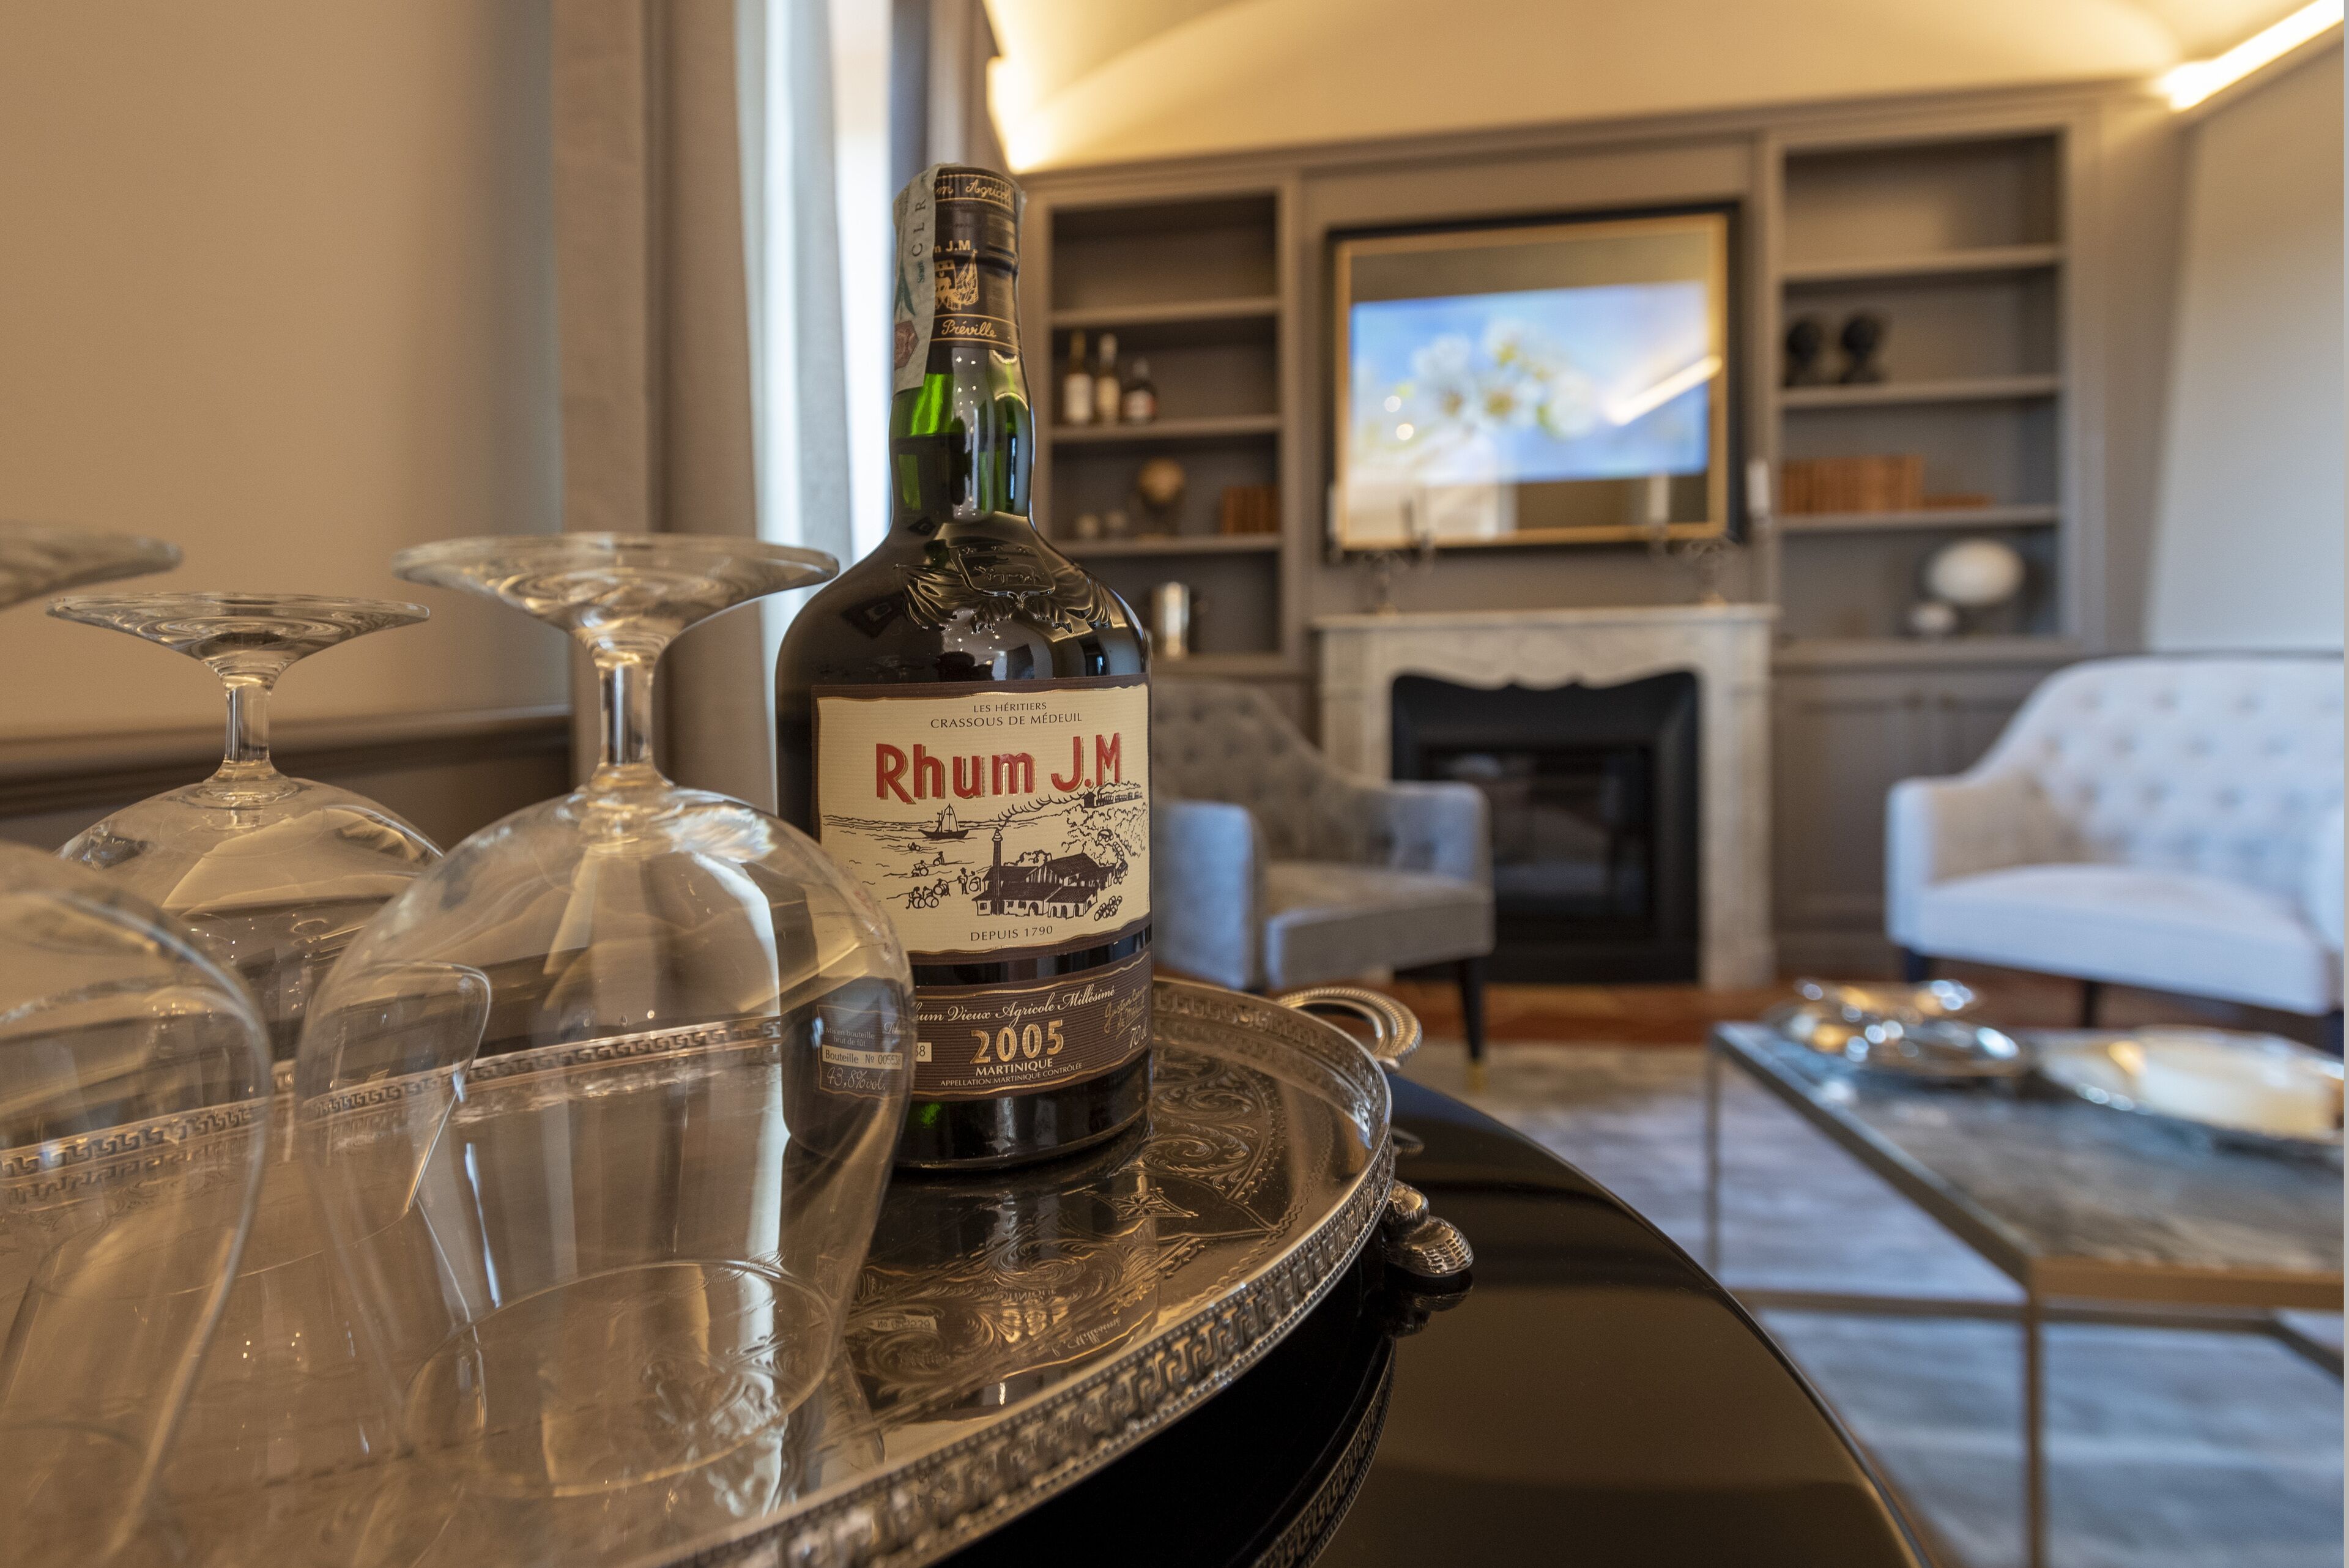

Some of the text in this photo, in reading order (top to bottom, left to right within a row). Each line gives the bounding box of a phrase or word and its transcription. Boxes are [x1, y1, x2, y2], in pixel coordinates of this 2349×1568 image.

[965, 179, 1010, 200] Agricol
[946, 240, 971, 252] J.M
[941, 319, 996, 338] Préville
[973, 702, 1047, 713] LES HÉRITIERS
[930, 712, 1082, 729] CRASSOUS DE MÉDEUIL
[876, 732, 1123, 805] Rhum J.M
[971, 925, 1053, 941] DEPUIS 1790
[915, 1001, 944, 1022] hum
[948, 1005, 991, 1022] Vieux
[995, 992, 1055, 1029] Agricole
[1057, 983, 1115, 1010] Millésimé
[846, 1029, 875, 1039] bouteille
[970, 1019, 1064, 1065] 2005
[825, 1050, 859, 1064] Bouteille
[940, 1062, 1083, 1087] APPELLATION MARTINIQUE CONTRÔLÉE
[976, 1058, 1053, 1077] MARTINIQUE
